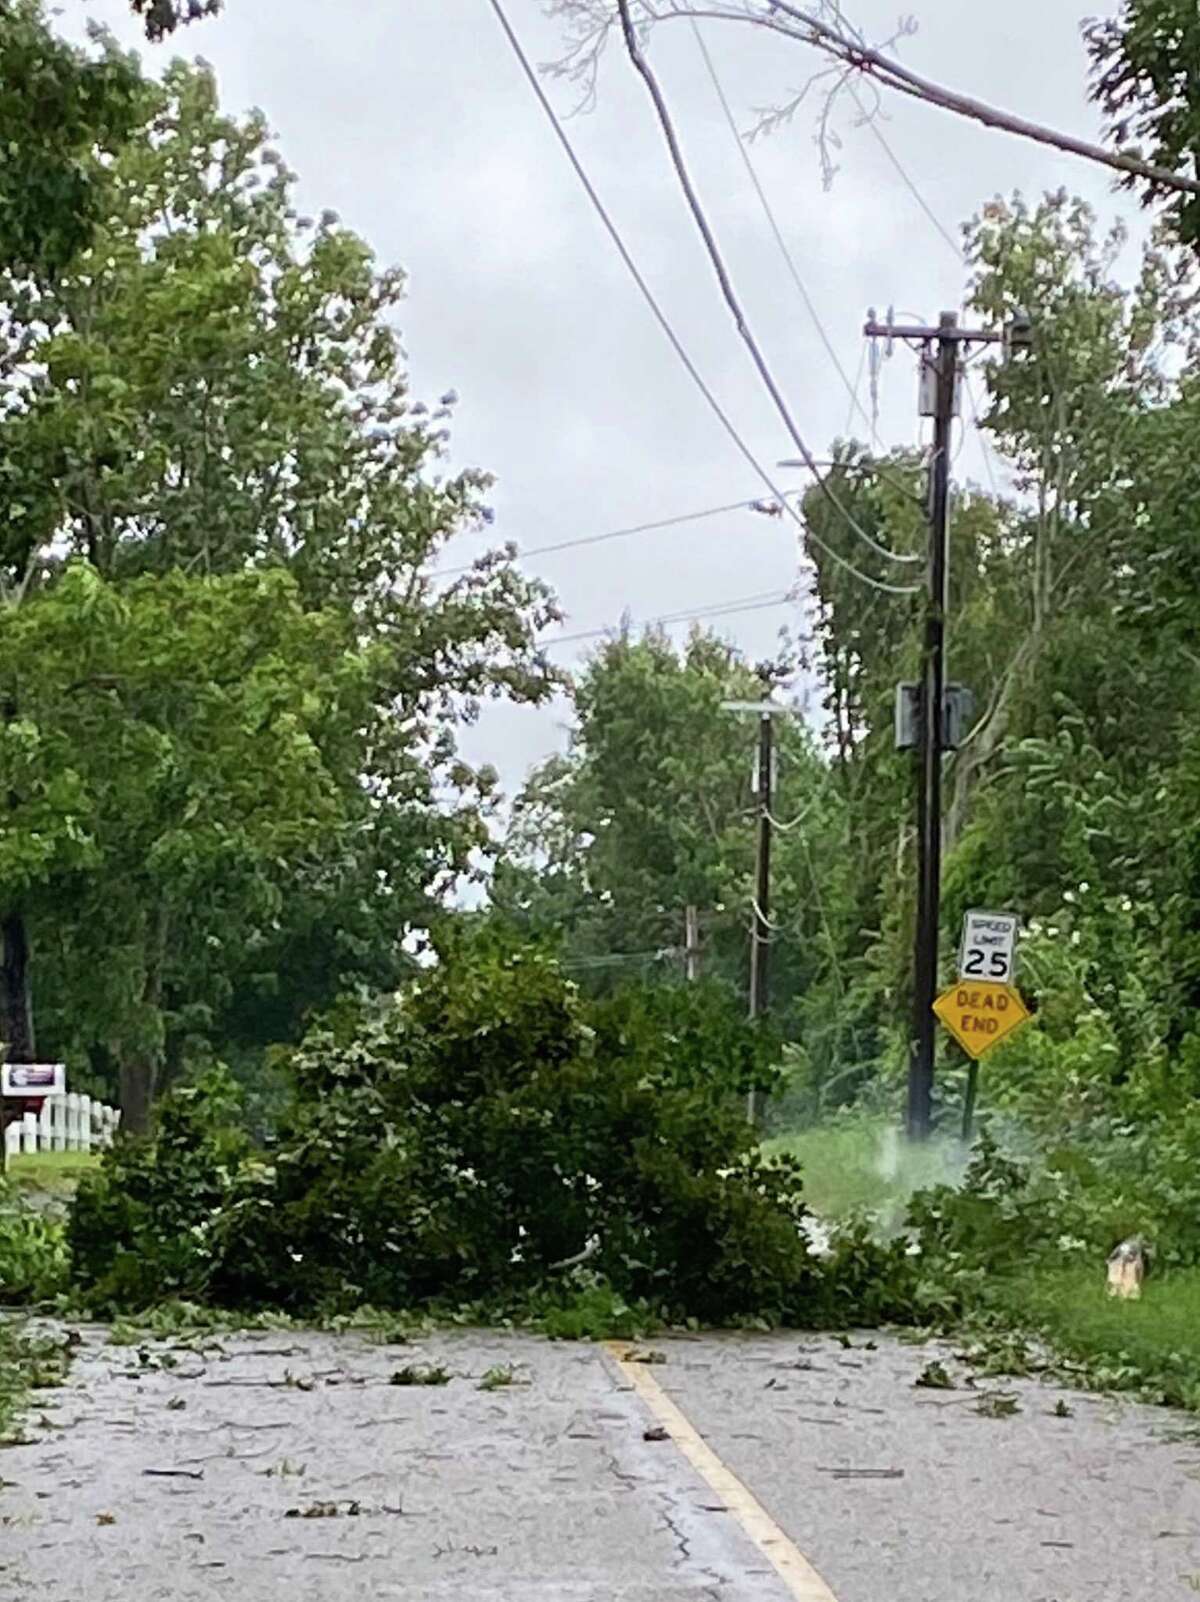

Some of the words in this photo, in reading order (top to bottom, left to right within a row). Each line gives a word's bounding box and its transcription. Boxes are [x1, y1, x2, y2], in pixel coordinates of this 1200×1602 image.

[971, 919, 1012, 933] SPEED
[973, 934, 1007, 946] LIMIT
[965, 949, 1008, 976] 25
[957, 990, 1008, 1011] DEAD
[961, 1015, 998, 1034] END
